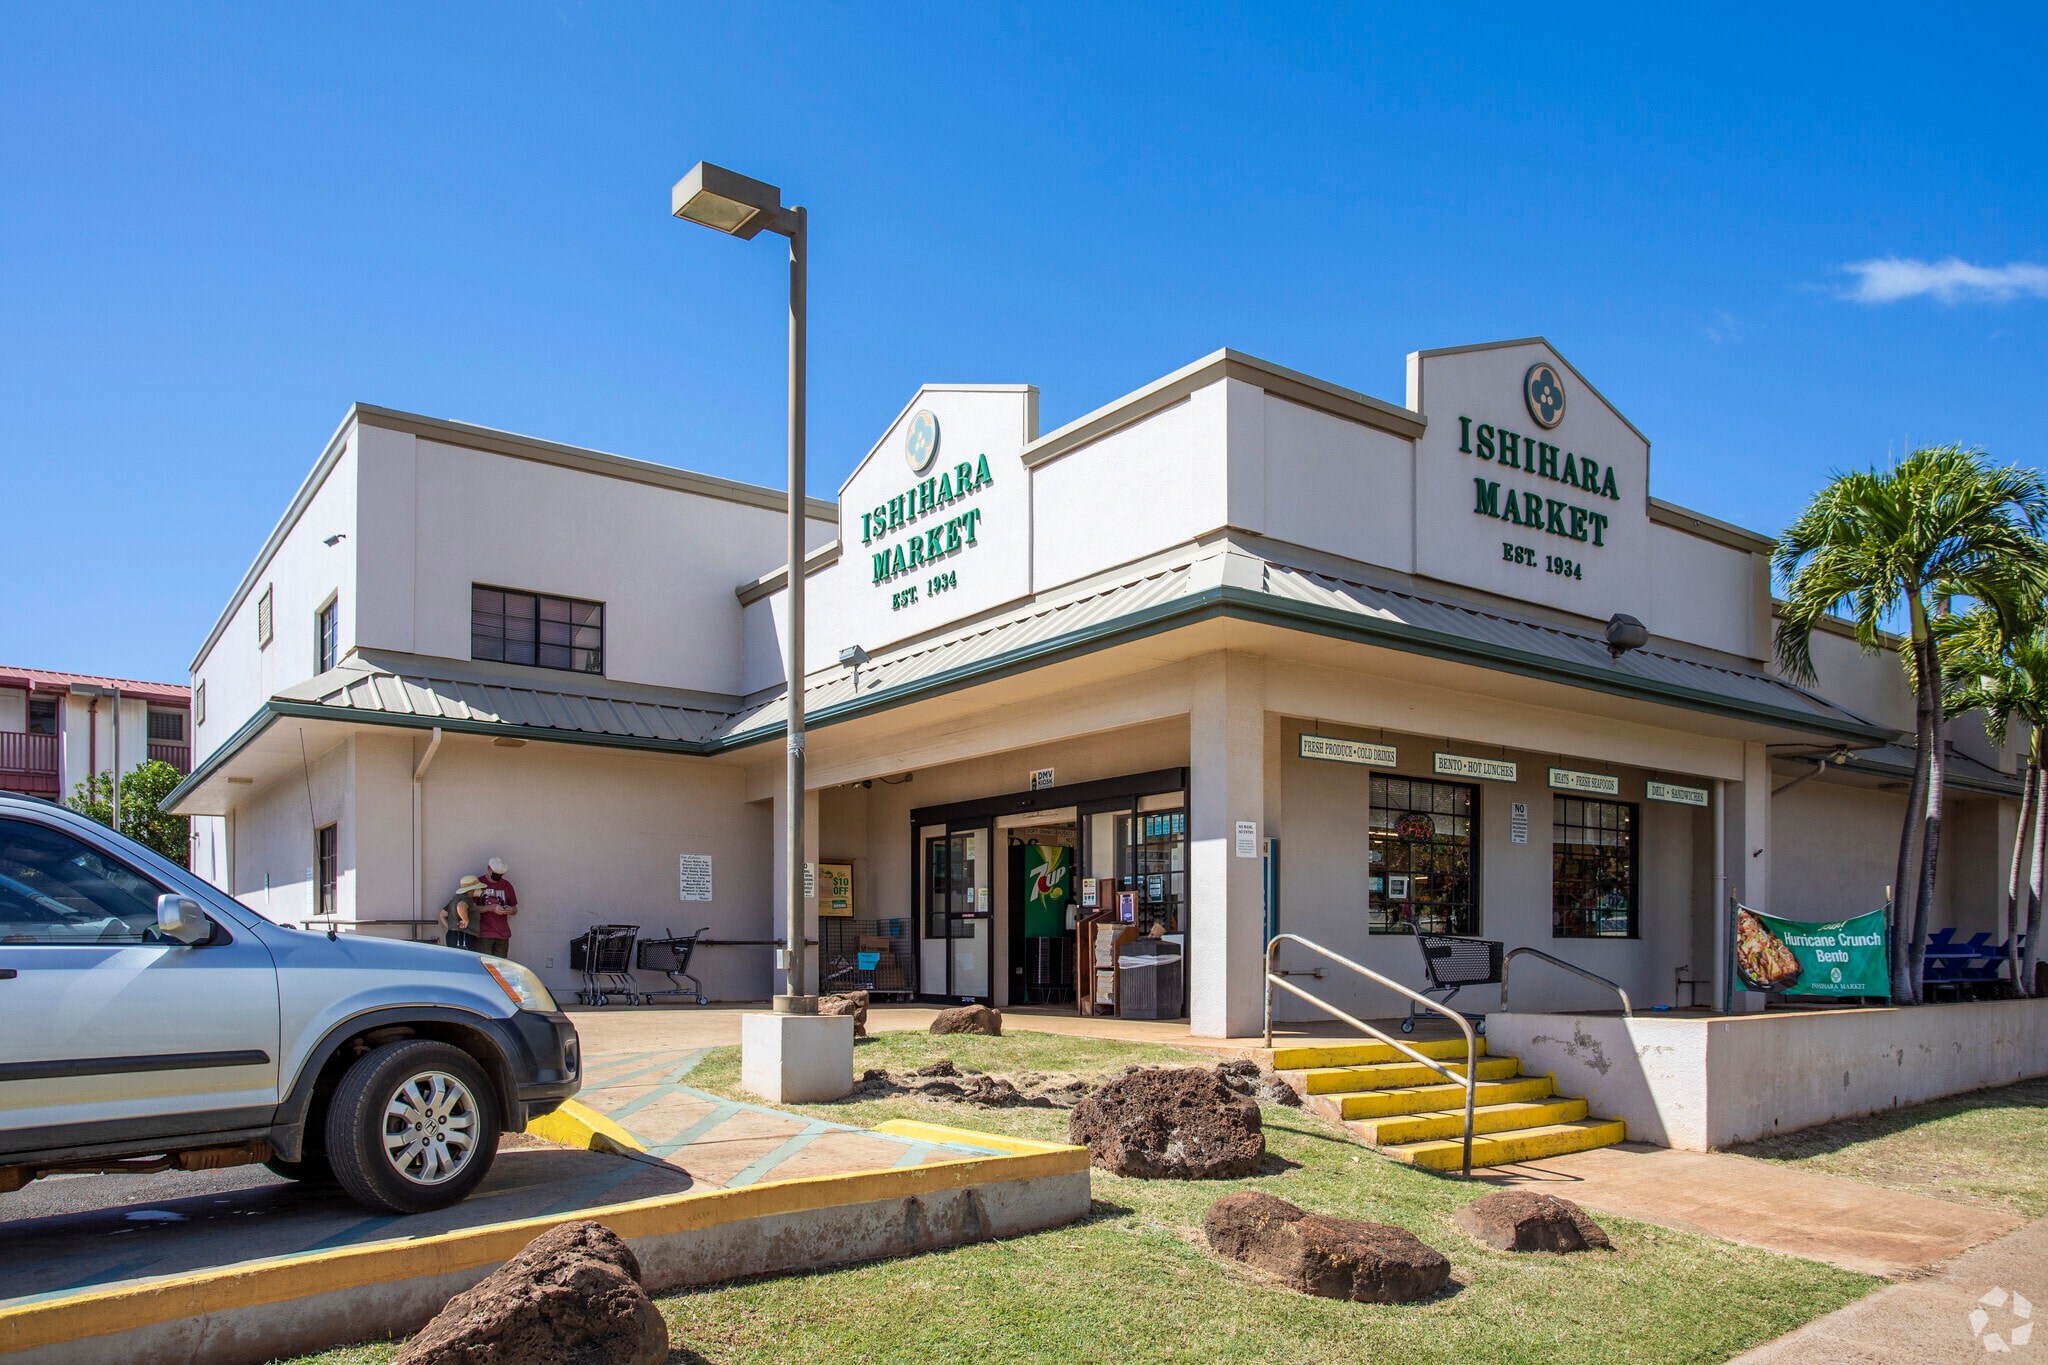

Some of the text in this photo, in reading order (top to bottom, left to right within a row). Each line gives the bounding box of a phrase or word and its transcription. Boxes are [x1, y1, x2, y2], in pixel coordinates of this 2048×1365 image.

[1459, 416, 1620, 500] ISHIHARA
[861, 453, 993, 544] ISHIHARA
[1474, 478, 1608, 547] MARKET
[872, 508, 981, 584] MARKET
[1502, 543, 1582, 580] EST. 1934
[891, 570, 957, 610] EST. 1934
[1303, 740, 1395, 762] FRESH PRODUCE COLD DRINKS
[1038, 770, 1053, 780] DMV
[1438, 757, 1514, 778] BENTO HOT LUNCHES
[1038, 778, 1053, 786] KIOSK
[1554, 772, 1615, 791] MEATS FRESH SEAFOODS
[1652, 785, 1704, 803] DELI SANDWICHES
[1515, 803, 1525, 813] NO
[833, 877, 849, 886] $10
[833, 886, 849, 895] OFF
[1030, 862, 1066, 902] 7UP
[1784, 931, 1881, 947] Hurricane Crunch
[1815, 949, 1849, 963] Bento
